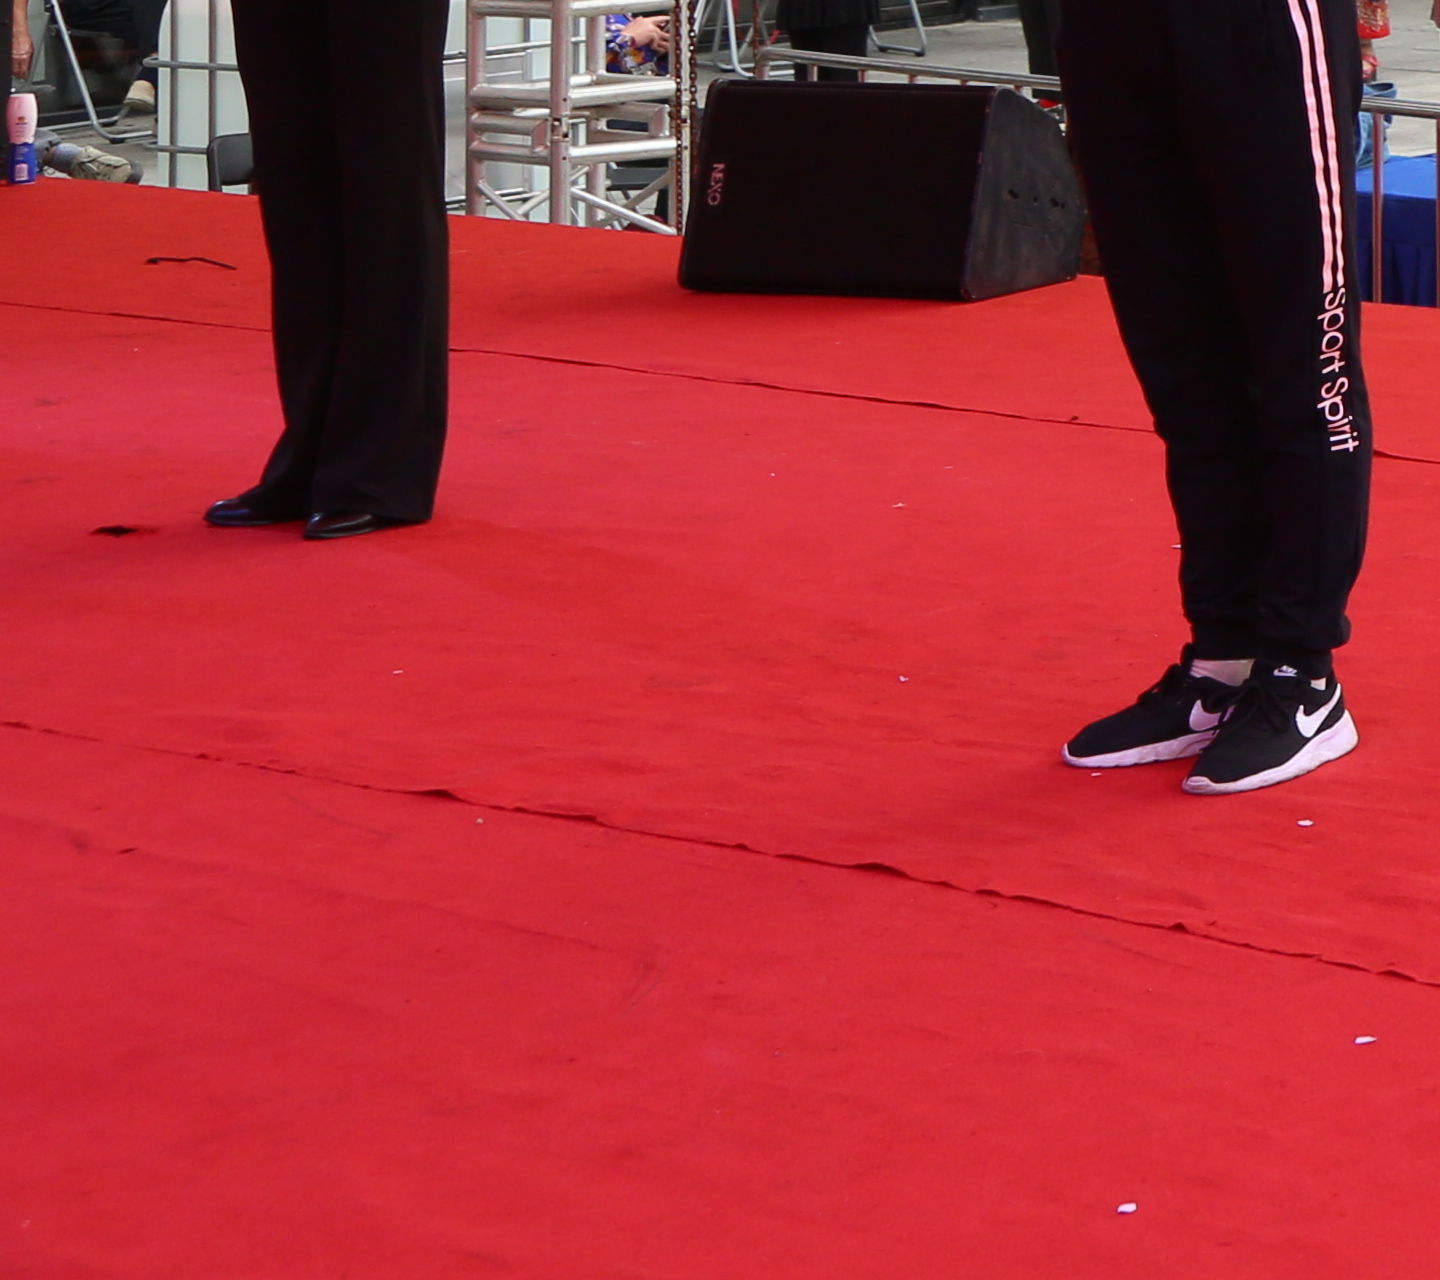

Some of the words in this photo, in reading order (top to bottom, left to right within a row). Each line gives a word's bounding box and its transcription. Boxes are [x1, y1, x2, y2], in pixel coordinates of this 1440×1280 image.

[707, 163, 726, 206] NEXO
[1316, 287, 1347, 375] Sport
[1316, 376, 1360, 453] Spirit
